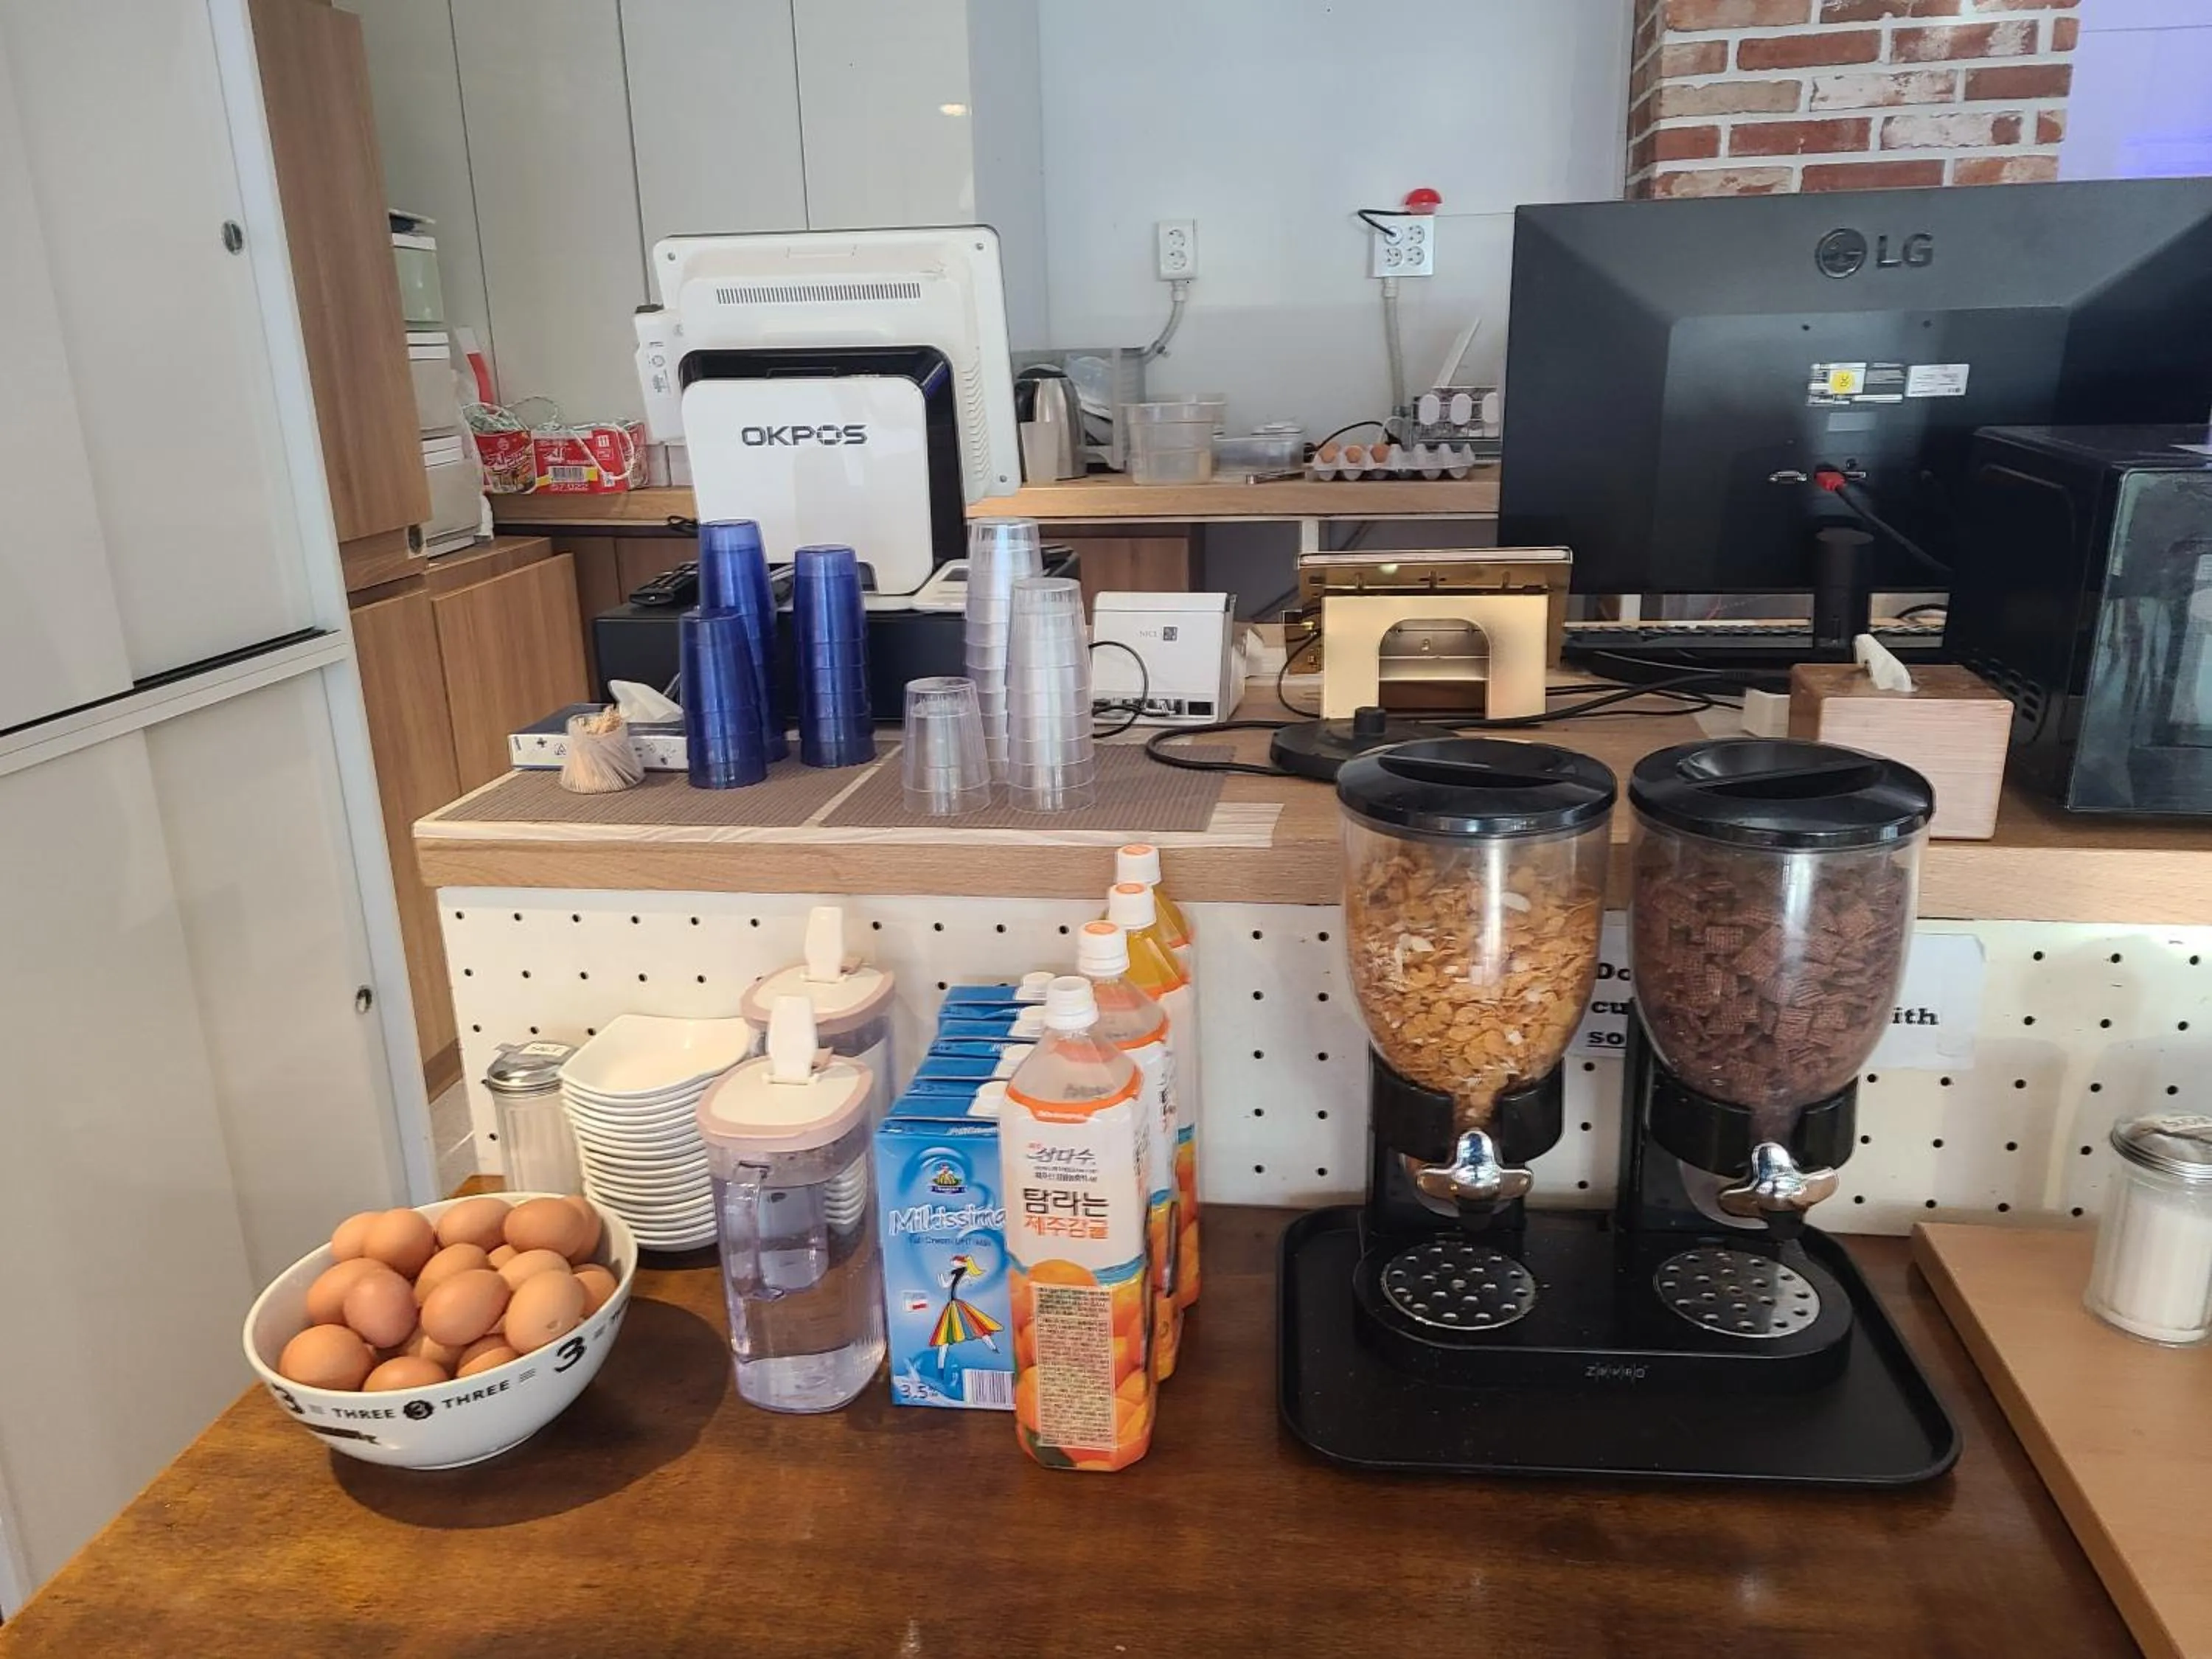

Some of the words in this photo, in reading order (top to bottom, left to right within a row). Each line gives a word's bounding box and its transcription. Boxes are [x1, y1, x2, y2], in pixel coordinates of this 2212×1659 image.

[1876, 232, 1933, 270] LG
[741, 425, 869, 446] OKPOS
[1891, 1007, 1940, 1026] ith
[1023, 1187, 1109, 1217] 탐라는
[1023, 1214, 1109, 1239] 제주감귤
[331, 1408, 397, 1419] THREE
[442, 1380, 510, 1409] THREE
[554, 1335, 587, 1374] 3
